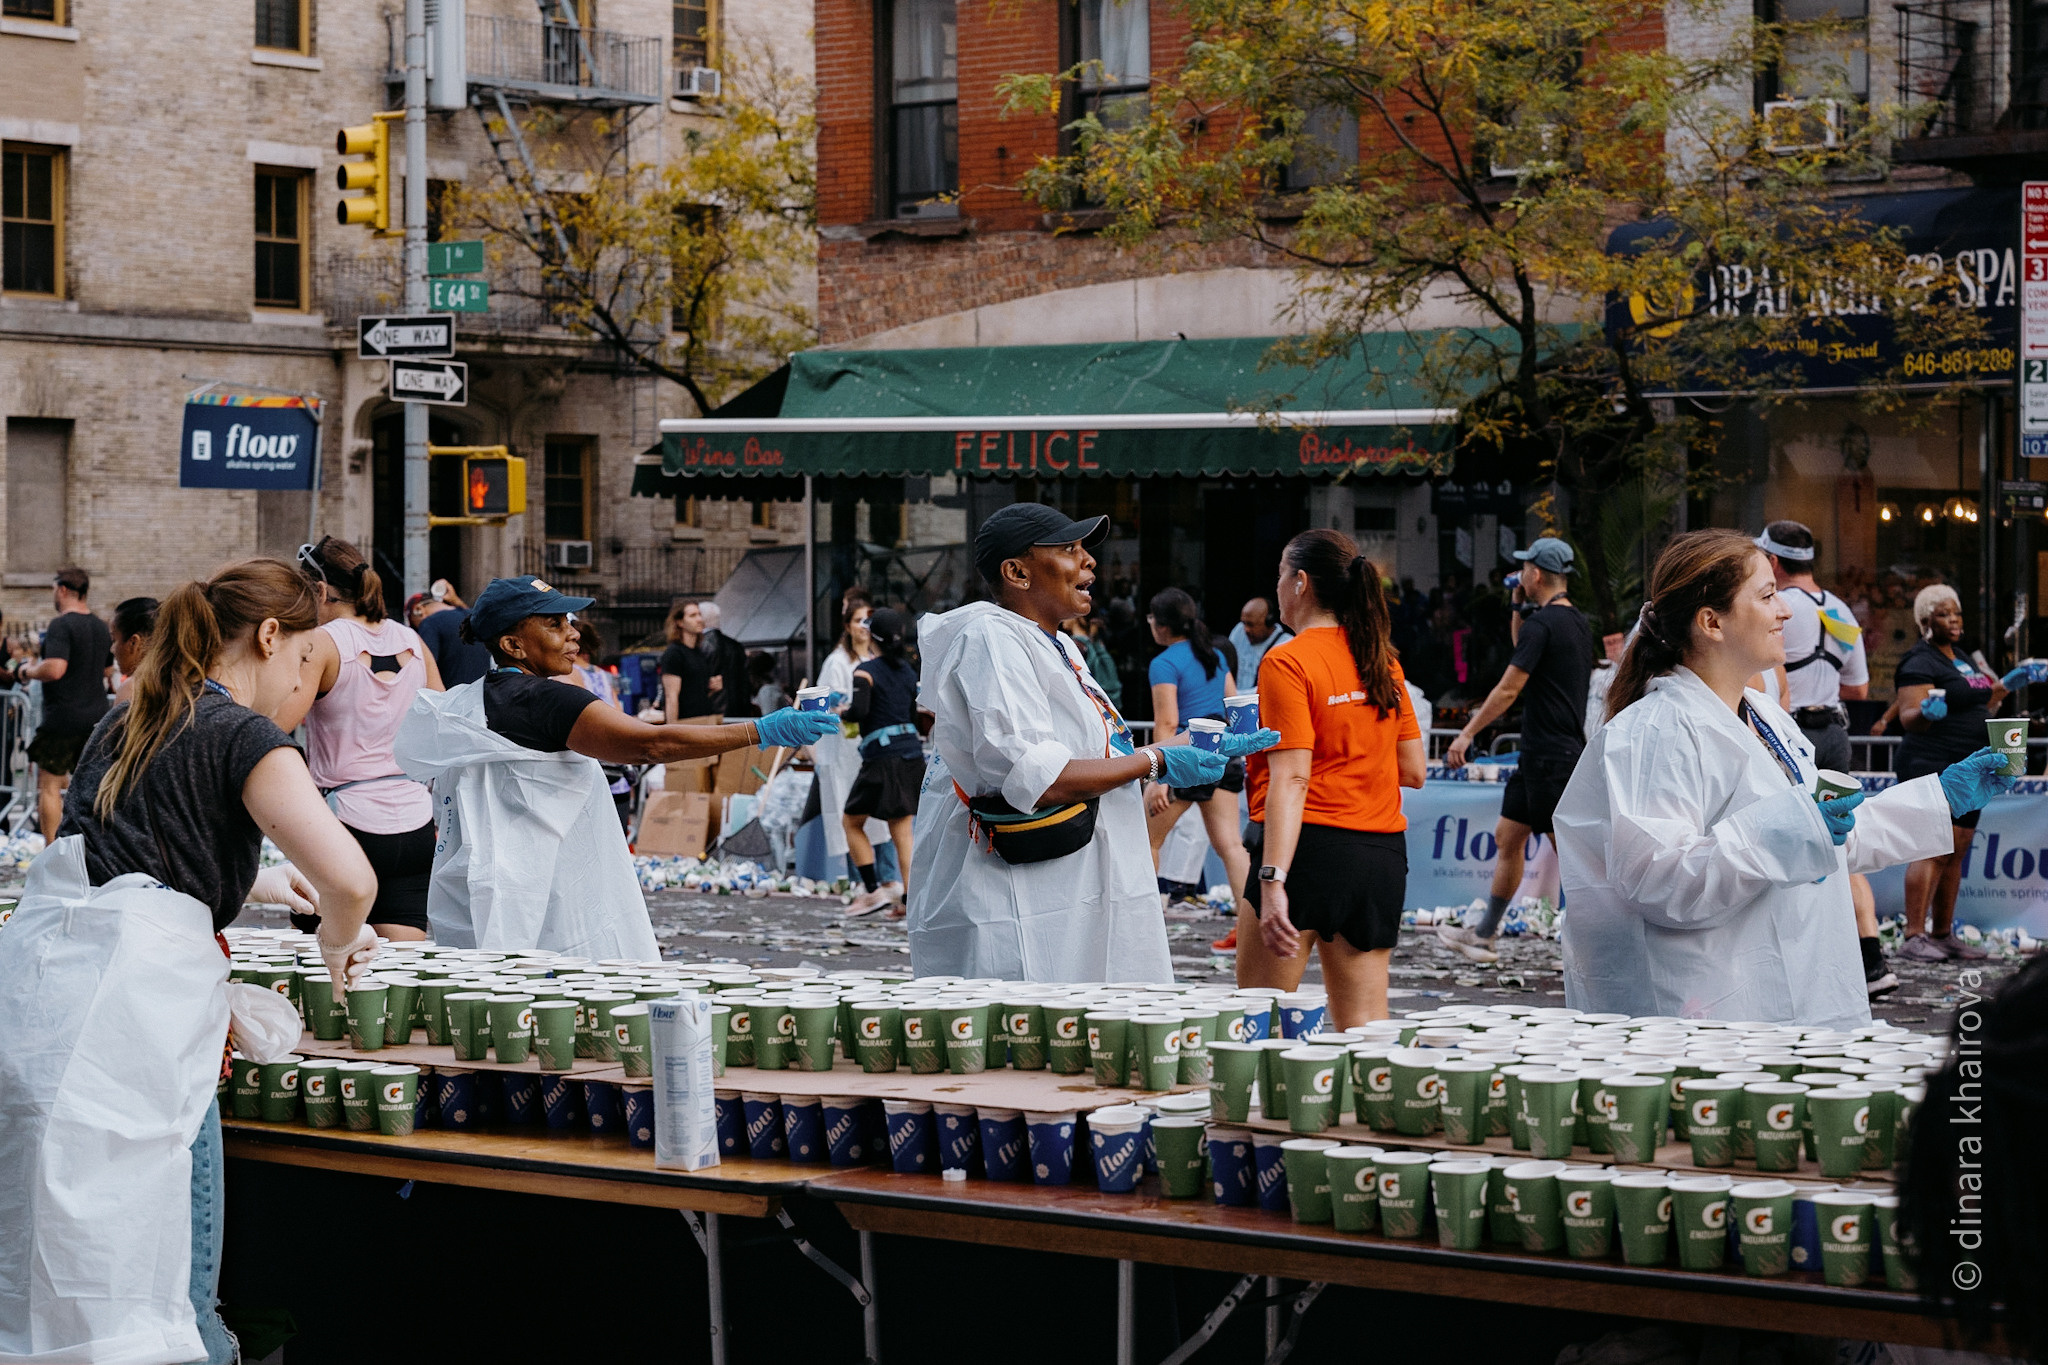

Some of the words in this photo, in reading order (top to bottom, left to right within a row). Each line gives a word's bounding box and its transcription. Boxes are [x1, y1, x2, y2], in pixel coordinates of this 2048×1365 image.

[445, 247, 451, 269] 1
[2031, 259, 2044, 280] 3
[1955, 248, 2016, 308] SPA
[434, 283, 443, 306] E
[448, 285, 465, 307] 64
[374, 330, 399, 344] ONE
[413, 329, 441, 343] WAY
[1826, 340, 1880, 365] Facial
[403, 373, 424, 388] ONE
[434, 377, 454, 389] WAY
[2030, 361, 2044, 382] 2
[225, 423, 296, 459] flow
[680, 437, 736, 466] Wine
[744, 436, 785, 466] Bar
[954, 431, 1101, 470] FELICE
[2004, 728, 2022, 747] G
[1776, 744, 1799, 774] MARATHON
[1961, 829, 2048, 880] flo
[1433, 867, 1473, 878] alkaline
[730, 1012, 750, 1033] G
[861, 1017, 881, 1039] G
[905, 1017, 923, 1039] G
[951, 1016, 974, 1039] G
[1009, 1013, 1030, 1036] G
[1056, 1016, 1079, 1039] G
[615, 1024, 630, 1046] G
[1164, 1029, 1180, 1054] G
[1179, 1026, 1203, 1049] G
[280, 1069, 298, 1091] G
[306, 1075, 326, 1096] G
[341, 1078, 356, 1099] G
[1313, 1068, 1334, 1094] G
[1368, 1067, 1392, 1092] G
[1417, 1073, 1439, 1099] G
[383, 1082, 405, 1104] G
[1692, 1099, 1718, 1126] G
[1767, 1103, 1795, 1130] G
[1099, 1138, 1135, 1178] flow
[1355, 1166, 1377, 1192] G
[1378, 1172, 1400, 1198] G
[1567, 1191, 1592, 1217] G
[1702, 1200, 1727, 1228] G
[1745, 1207, 1773, 1235] G
[1831, 1215, 1861, 1242] G
